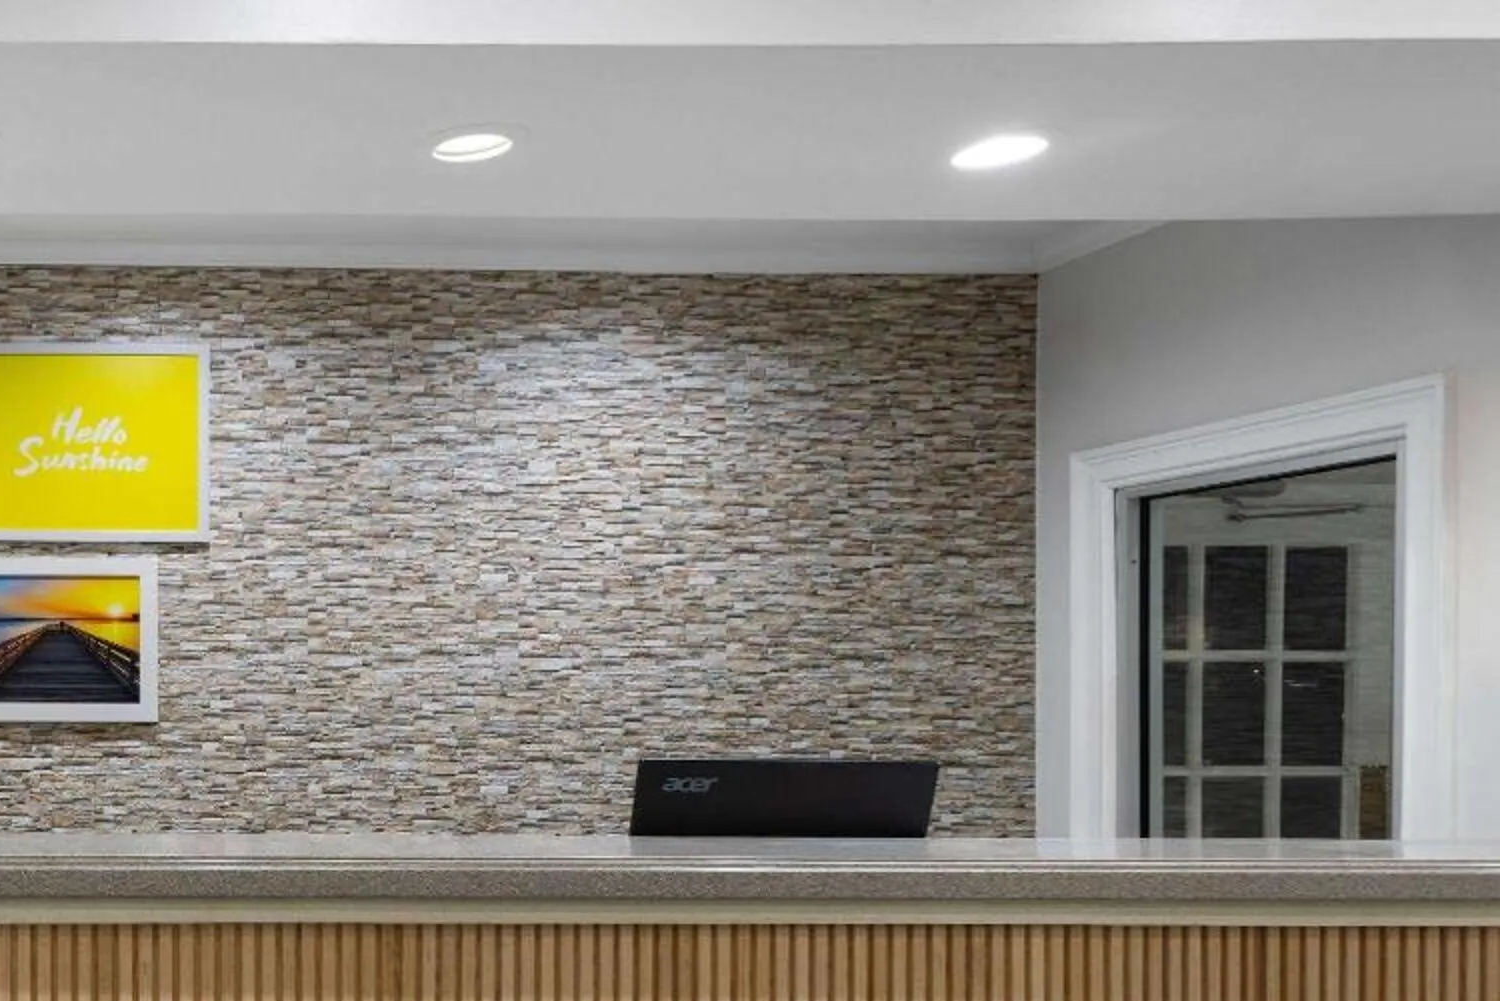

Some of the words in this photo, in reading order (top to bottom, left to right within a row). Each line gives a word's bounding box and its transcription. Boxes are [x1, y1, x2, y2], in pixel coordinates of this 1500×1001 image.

[51, 405, 128, 445] Hello
[12, 434, 149, 478] Sunshine
[661, 776, 719, 793] acer
